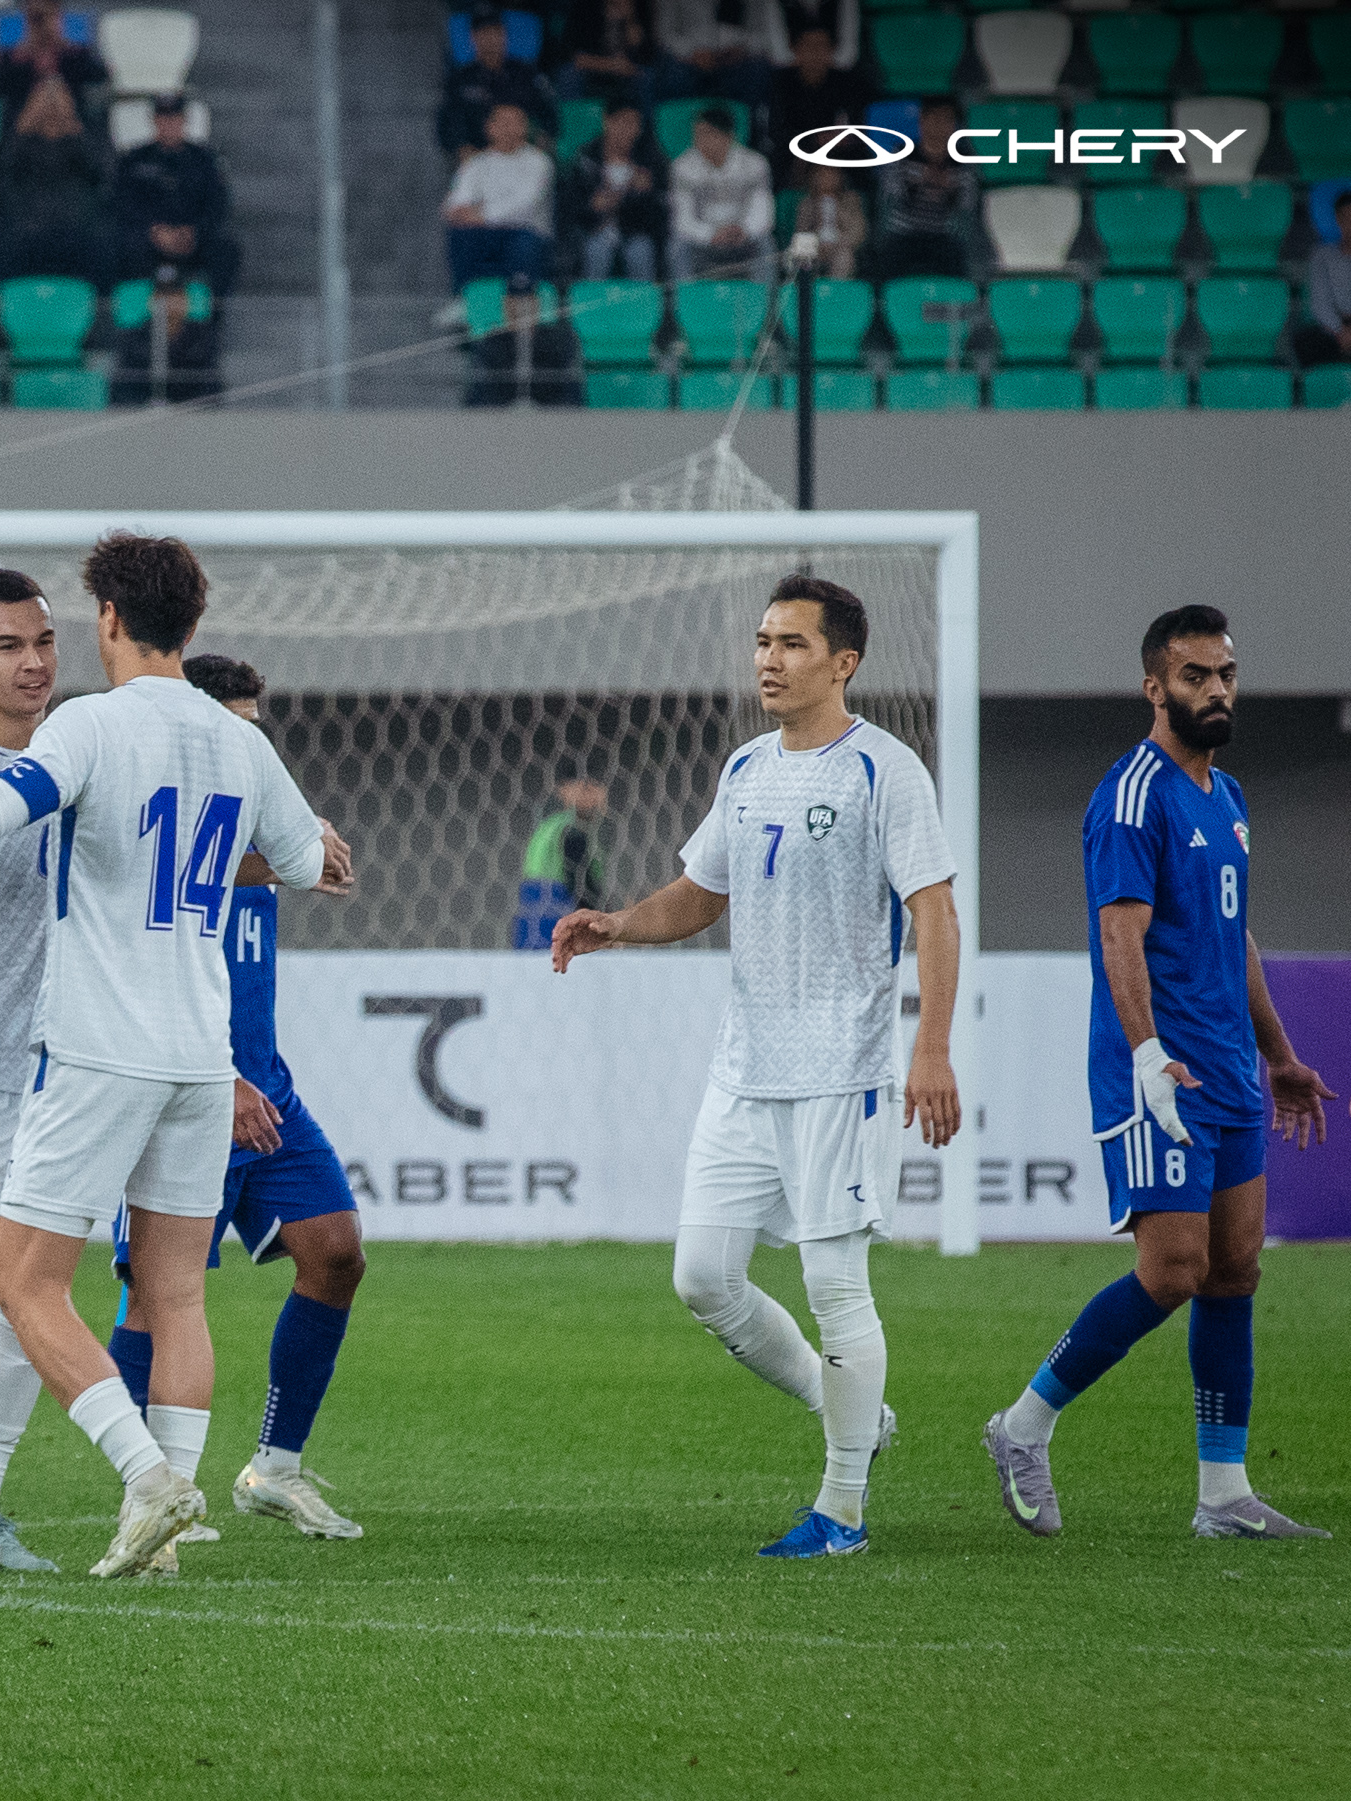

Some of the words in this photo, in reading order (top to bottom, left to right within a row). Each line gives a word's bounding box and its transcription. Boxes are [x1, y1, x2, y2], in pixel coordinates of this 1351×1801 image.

[809, 809, 833, 826] UFA
[138, 786, 244, 938] 14
[761, 823, 784, 879] 7
[1219, 864, 1239, 919] 8
[237, 907, 262, 963] 14
[1164, 1149, 1187, 1187] 8
